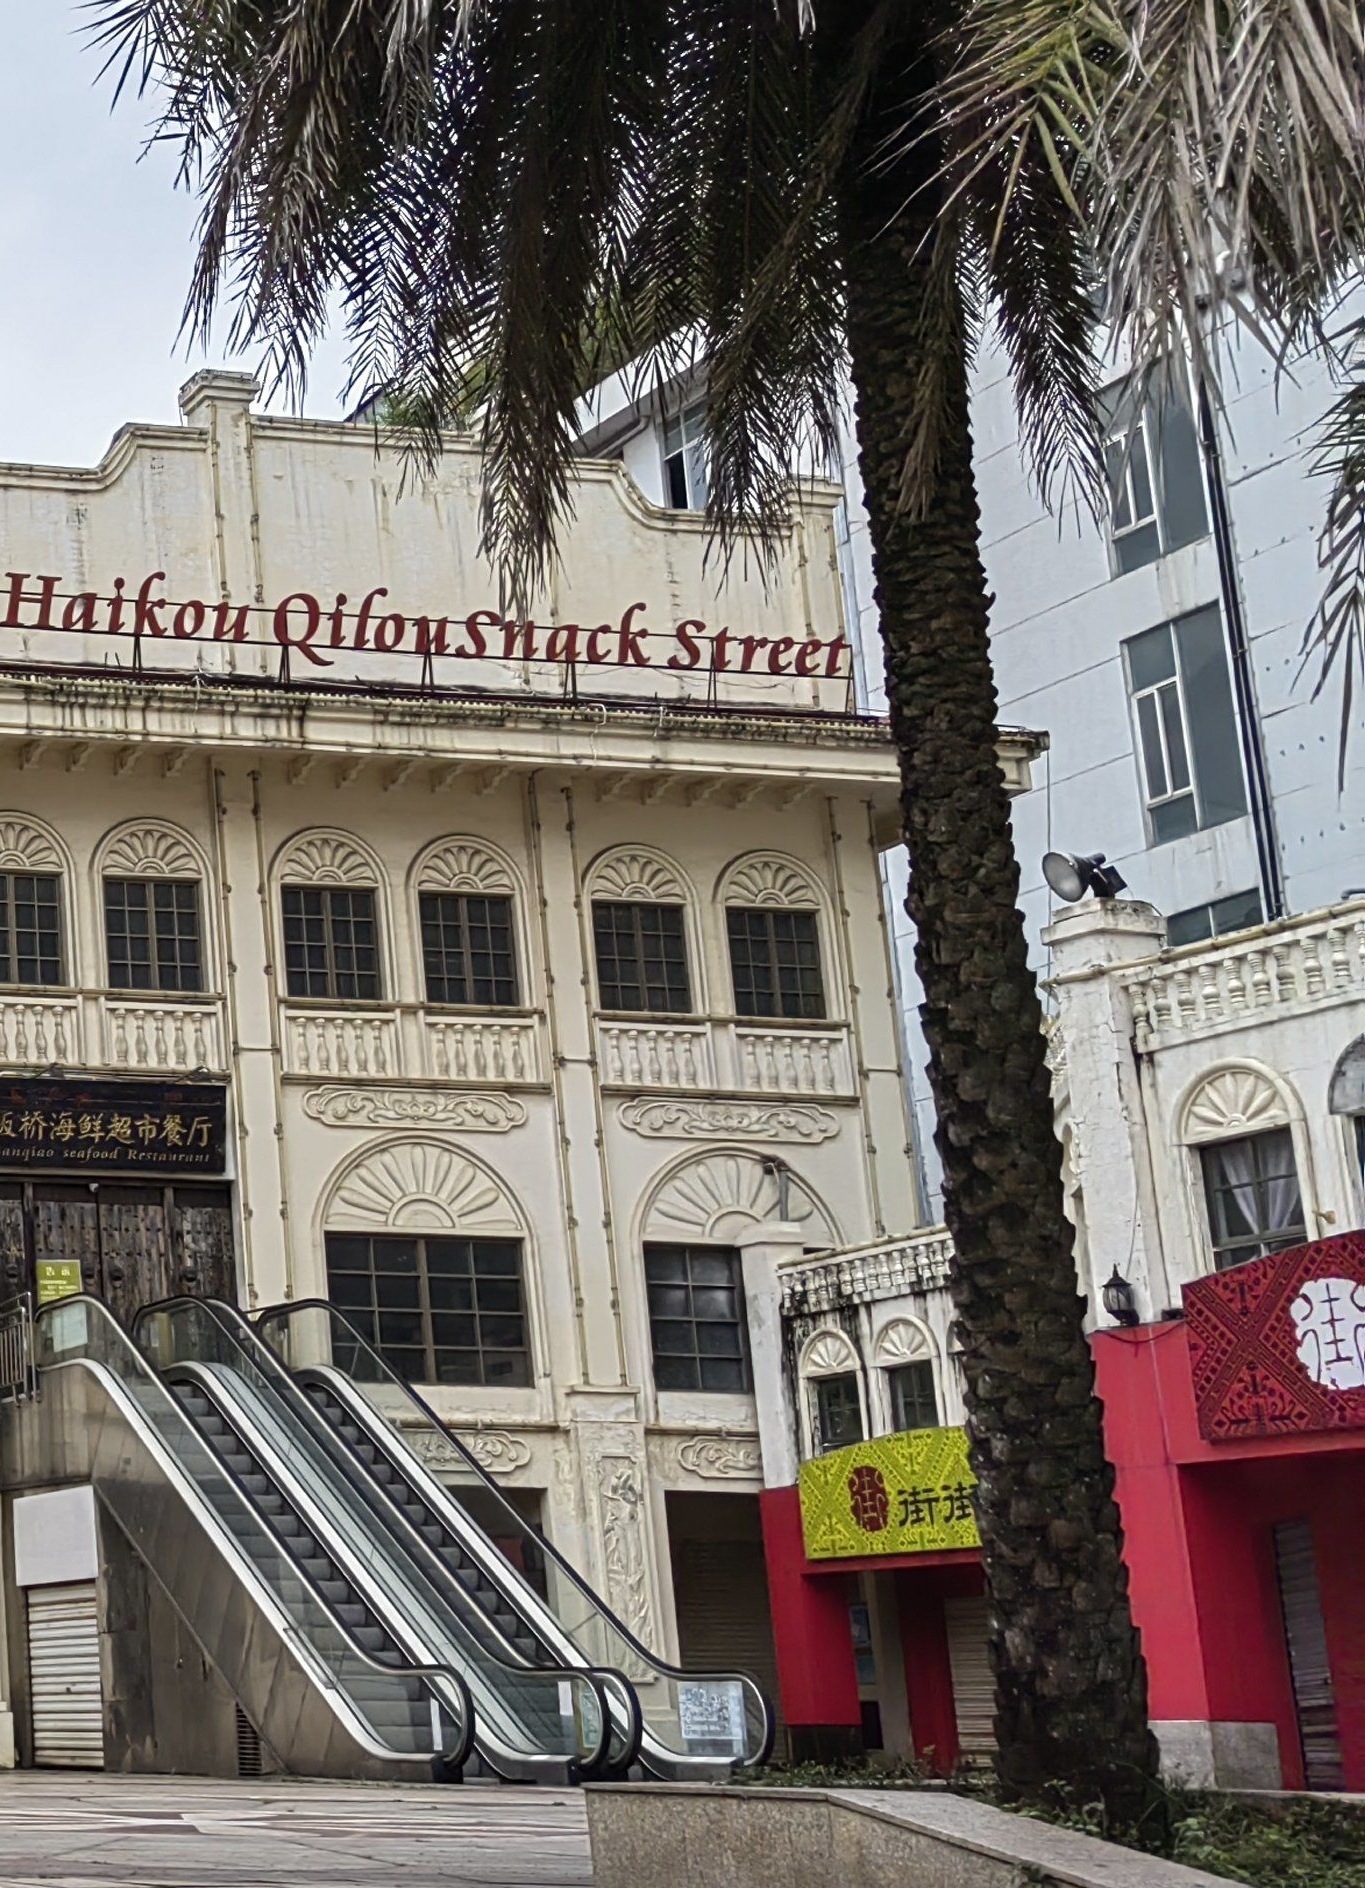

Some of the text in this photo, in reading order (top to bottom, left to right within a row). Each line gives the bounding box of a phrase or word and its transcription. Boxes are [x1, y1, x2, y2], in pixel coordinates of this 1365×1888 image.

[0, 570, 251, 643] Haikou
[666, 618, 850, 678] Street
[127, 1147, 211, 1163] Restaurant
